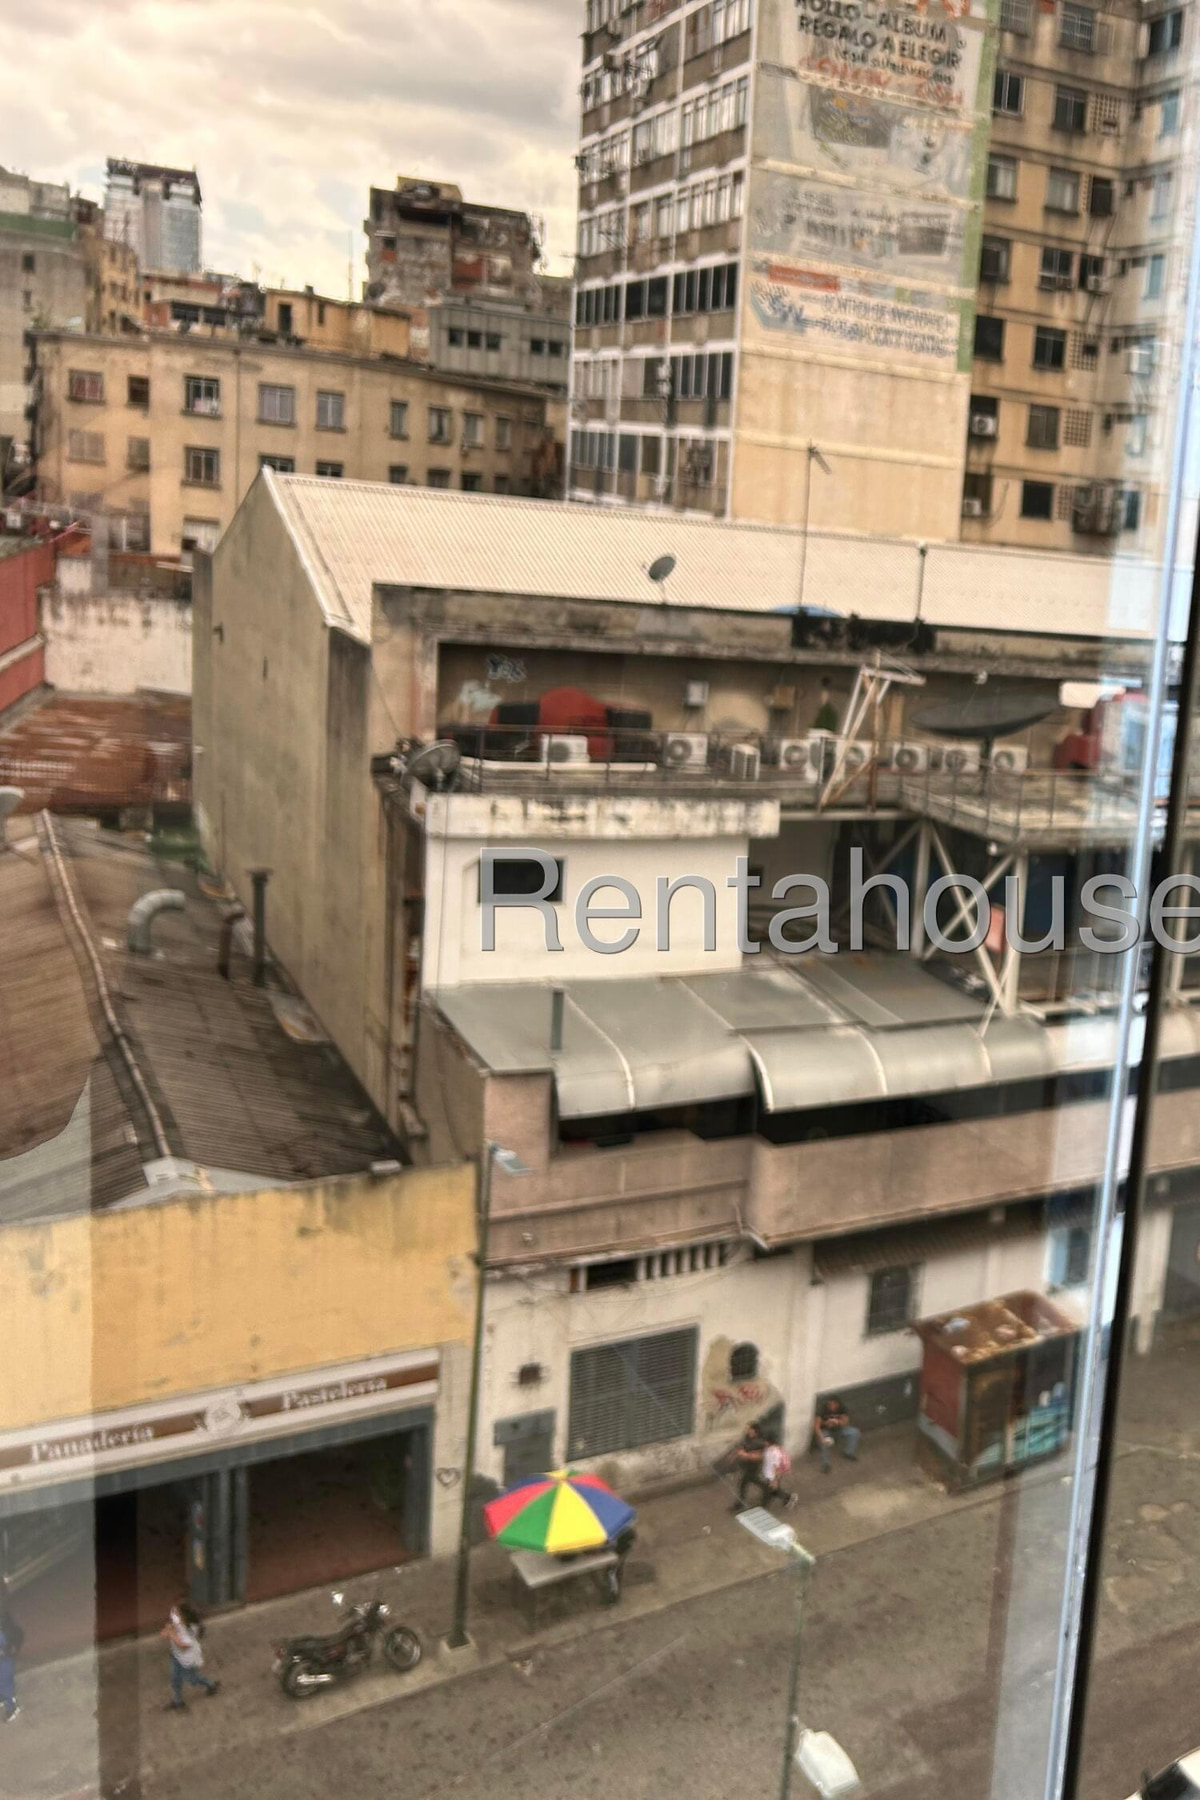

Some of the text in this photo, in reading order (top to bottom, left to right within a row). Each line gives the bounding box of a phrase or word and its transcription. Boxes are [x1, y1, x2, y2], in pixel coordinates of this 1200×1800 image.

[797, 14, 877, 48] REGALO
[881, 35, 895, 53] A
[899, 39, 962, 70] ELEGIR
